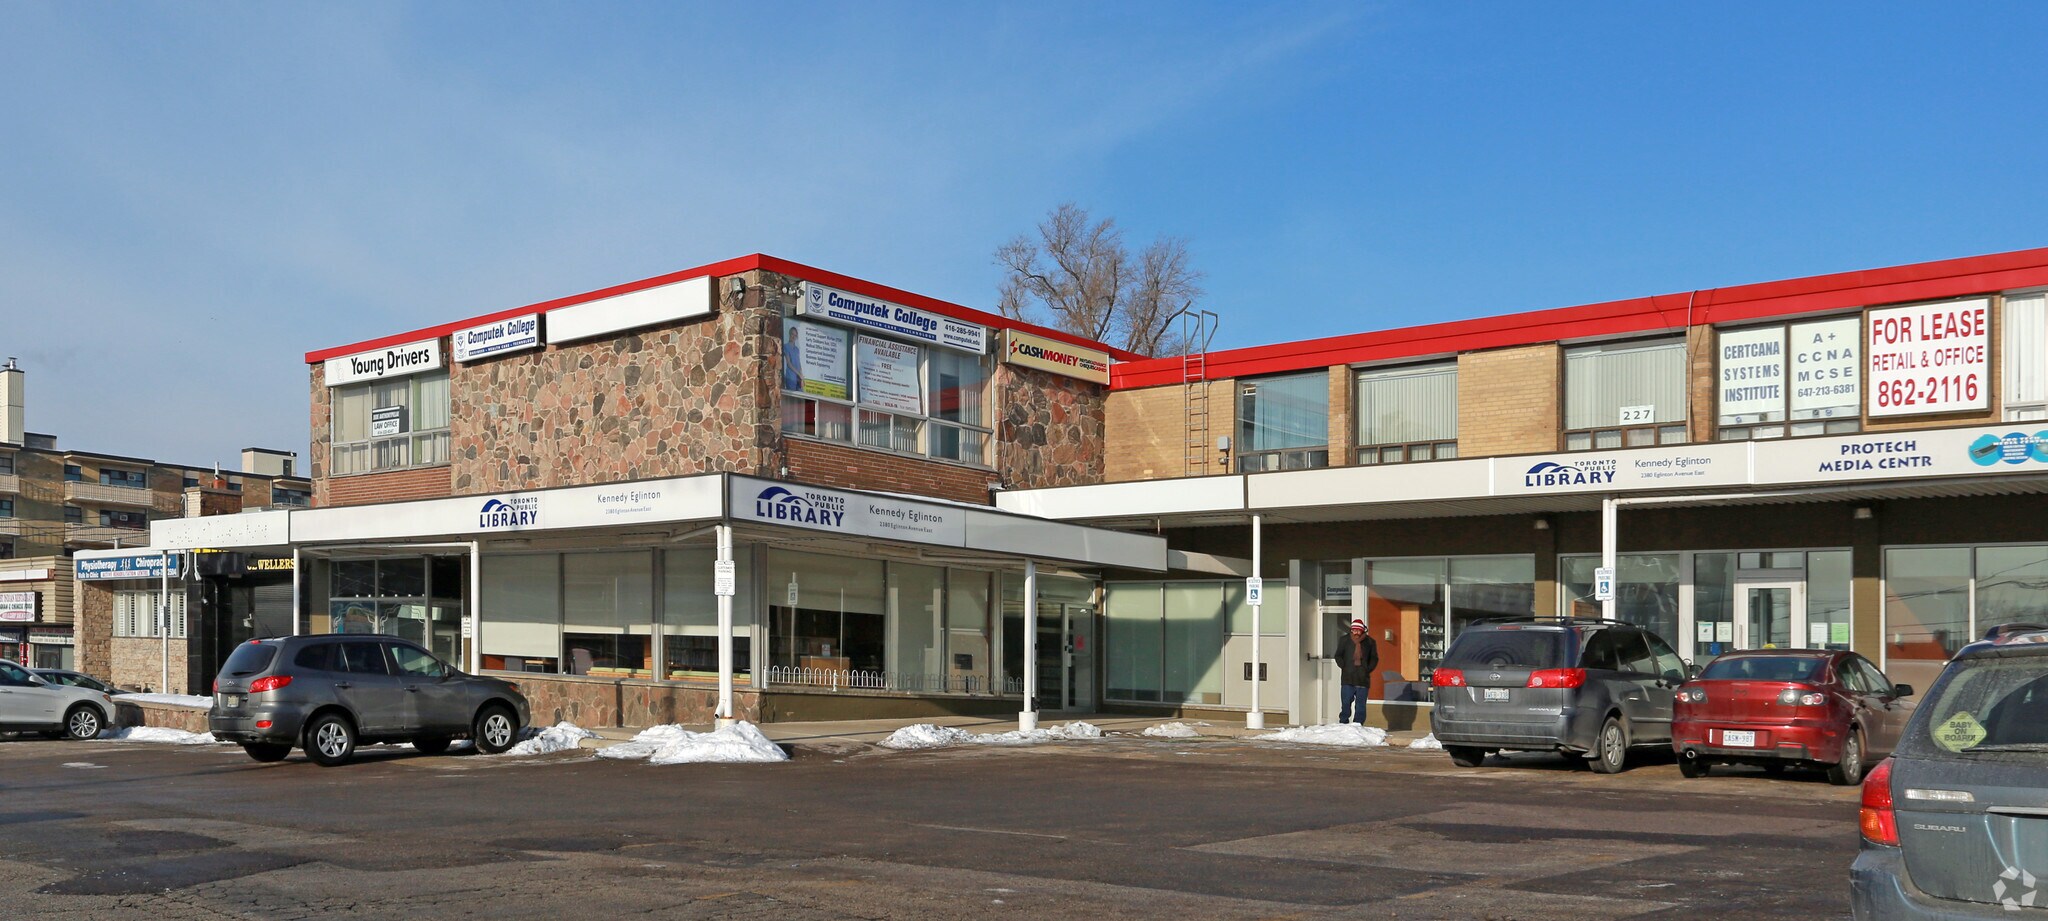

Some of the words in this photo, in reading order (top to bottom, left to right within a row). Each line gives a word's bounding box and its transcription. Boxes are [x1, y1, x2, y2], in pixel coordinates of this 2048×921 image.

[828, 292, 889, 319] Computek
[894, 307, 938, 331] College
[468, 324, 504, 344] Computek
[507, 319, 535, 335] College
[831, 311, 857, 321] BUSINESS
[902, 327, 936, 340] TECHNOLOGY
[944, 323, 981, 338] 416-285-9941
[1872, 316, 1912, 345] FOR
[1920, 309, 1985, 341] LEASE
[858, 336, 887, 349] FINANCIAL
[888, 343, 917, 355] ASSISTANCE
[1724, 341, 1780, 360] CERTCANA
[873, 348, 901, 360] AVAILABLE
[1797, 348, 1853, 364] CCNA
[1872, 352, 1916, 372] RETAIL
[1920, 350, 1930, 368] &
[1934, 345, 1984, 367] OFFICE
[351, 357, 384, 376] Young
[387, 348, 430, 369] Drivers
[881, 363, 892, 371] FREE
[1724, 363, 1780, 381] SYSTEMS
[1797, 366, 1853, 382] MCSE
[1725, 385, 1780, 403] INSTITUTE
[1797, 384, 1855, 398] 647-213-6381
[1877, 373, 1978, 407] 862-2116
[1623, 409, 1651, 421] 227
[374, 421, 383, 430] LAW
[384, 420, 398, 428] OFFICE
[1841, 440, 1916, 455] PROTECH
[1574, 459, 1617, 467] TORONTO
[1634, 457, 1673, 469] Kennedy
[1675, 455, 1712, 467] Eglinton
[1818, 459, 1873, 472] MEDIA
[1878, 456, 1933, 469] CENTR
[1525, 470, 1616, 487] LIBRARY
[1653, 471, 1673, 479] Eglinton
[510, 497, 538, 505] TORONTO
[597, 493, 628, 504] Kennedy
[630, 490, 661, 503] Eglinton
[805, 492, 845, 504] TORONTO
[516, 503, 538, 511] PUBLIC
[756, 500, 845, 527] LIBRARY
[814, 502, 845, 511] PUBLIC
[869, 504, 906, 518] Kennedy
[908, 509, 943, 523] Eglinton
[479, 510, 538, 528] LIBRARY
[81, 559, 118, 572] Physiotherapy
[1949, 721, 1972, 729] BABY
[1944, 734, 1976, 742] BOARD!
[1913, 823, 1967, 833] SUBARU
